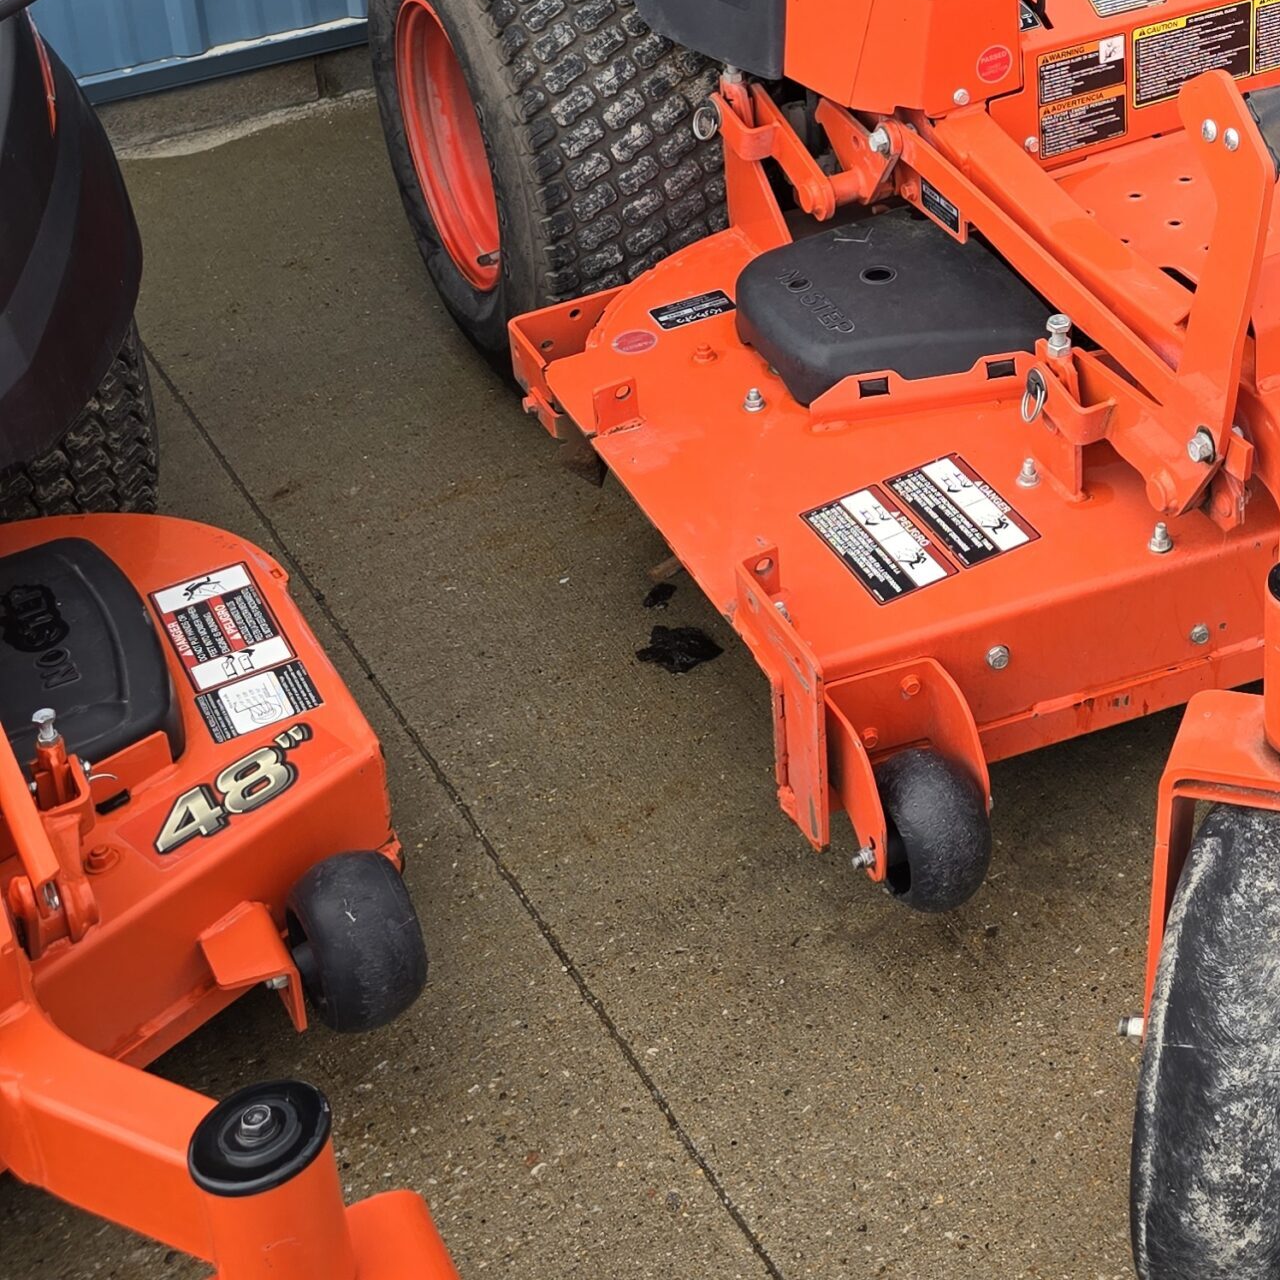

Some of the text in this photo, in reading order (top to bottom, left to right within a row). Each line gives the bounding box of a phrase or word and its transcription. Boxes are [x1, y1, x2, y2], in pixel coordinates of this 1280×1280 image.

[1146, 21, 1178, 35] CAUTION
[1049, 46, 1086, 61] WARNING
[1051, 92, 1105, 112] ADVERTENCIA
[774, 268, 857, 334] NO STEP
[979, 482, 1012, 513] DANGER
[897, 516, 932, 548] PELIGRO
[213, 603, 237, 634] PELIGRO
[167, 620, 190, 651] DANGER
[192, 643, 204, 654] NOT
[206, 645, 218, 657] FEET
[154, 722, 314, 856] 48"
